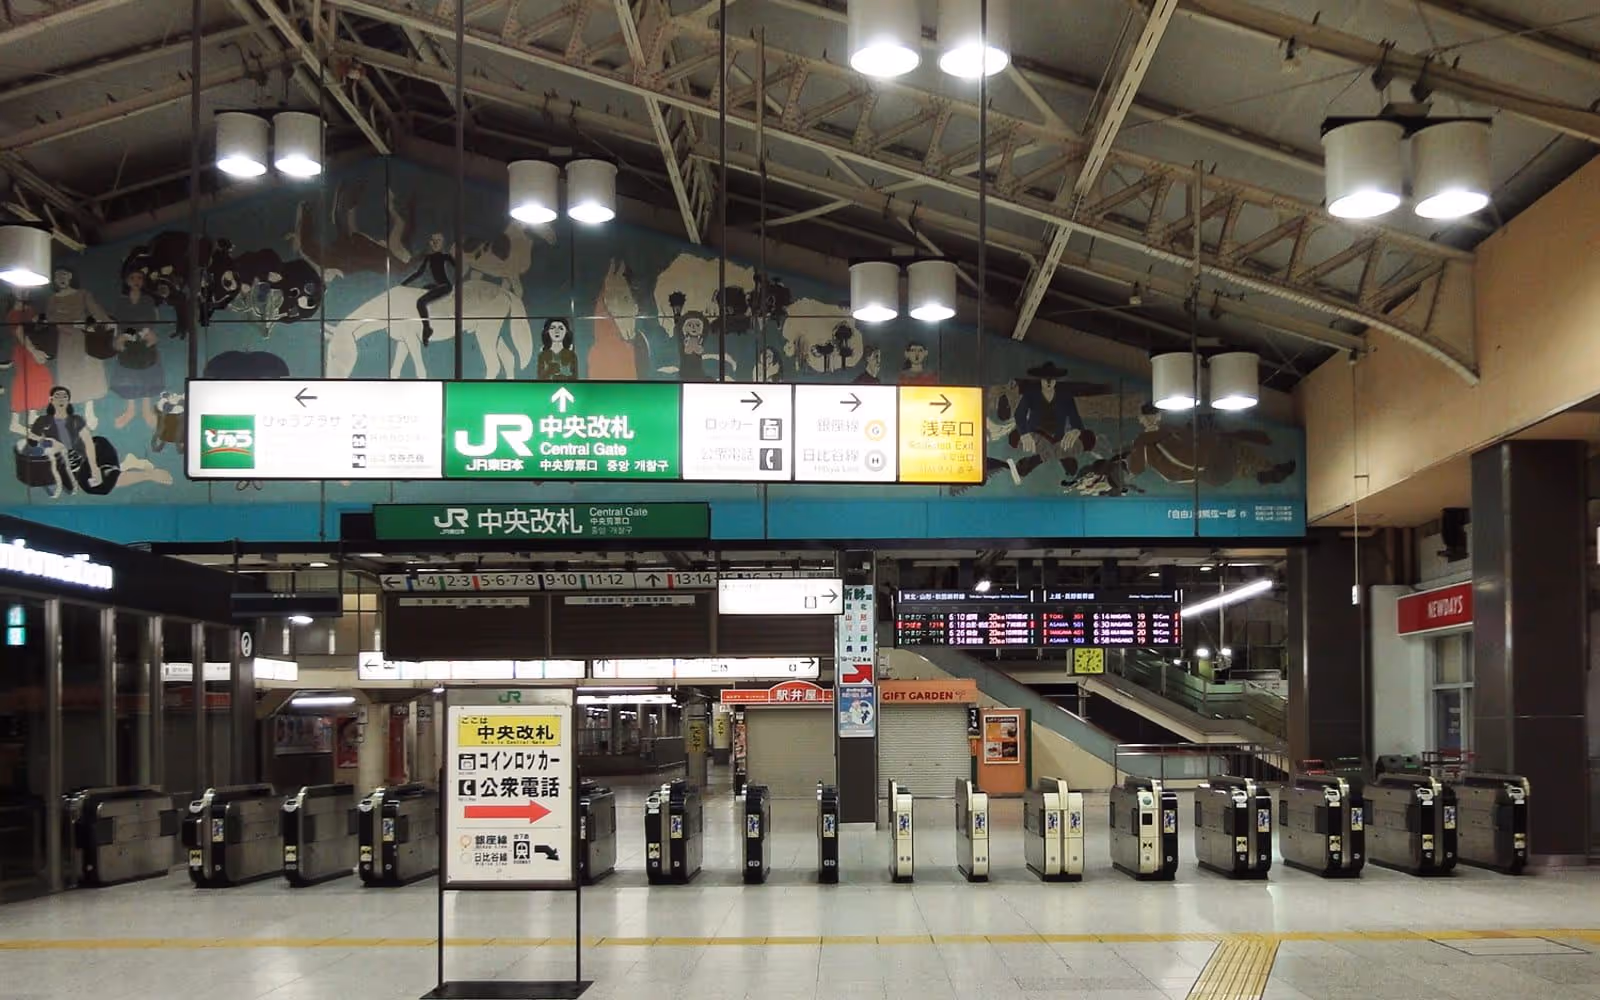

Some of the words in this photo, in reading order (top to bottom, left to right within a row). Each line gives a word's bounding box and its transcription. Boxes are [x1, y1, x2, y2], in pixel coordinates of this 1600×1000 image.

[540, 416, 634, 439] 中央改札
[705, 417, 753, 430] ロッカー
[921, 420, 974, 437] 浅草口
[455, 414, 533, 456] JR
[540, 442, 589, 455] Central
[593, 442, 627, 455] Gate
[803, 448, 859, 462] 日比谷線
[466, 459, 524, 472] JR東日本
[540, 460, 598, 472] 中央剪票口
[606, 460, 630, 473] 중앙
[634, 460, 670, 473] 개찰구
[433, 508, 469, 528] JR
[590, 507, 623, 517] Central
[625, 507, 648, 517] Gate
[478, 508, 583, 534] 中央改札
[499, 691, 521, 703] JR
[776, 689, 817, 701] 駅弁屋
[883, 692, 906, 700] GIFT
[909, 692, 953, 700] GARDEN
[478, 725, 554, 740] 中央改札
[480, 750, 560, 770] コインロッカー
[481, 776, 560, 798] 公衆電話
[475, 835, 507, 845] 銀座線
[475, 852, 507, 862] 日比谷線
